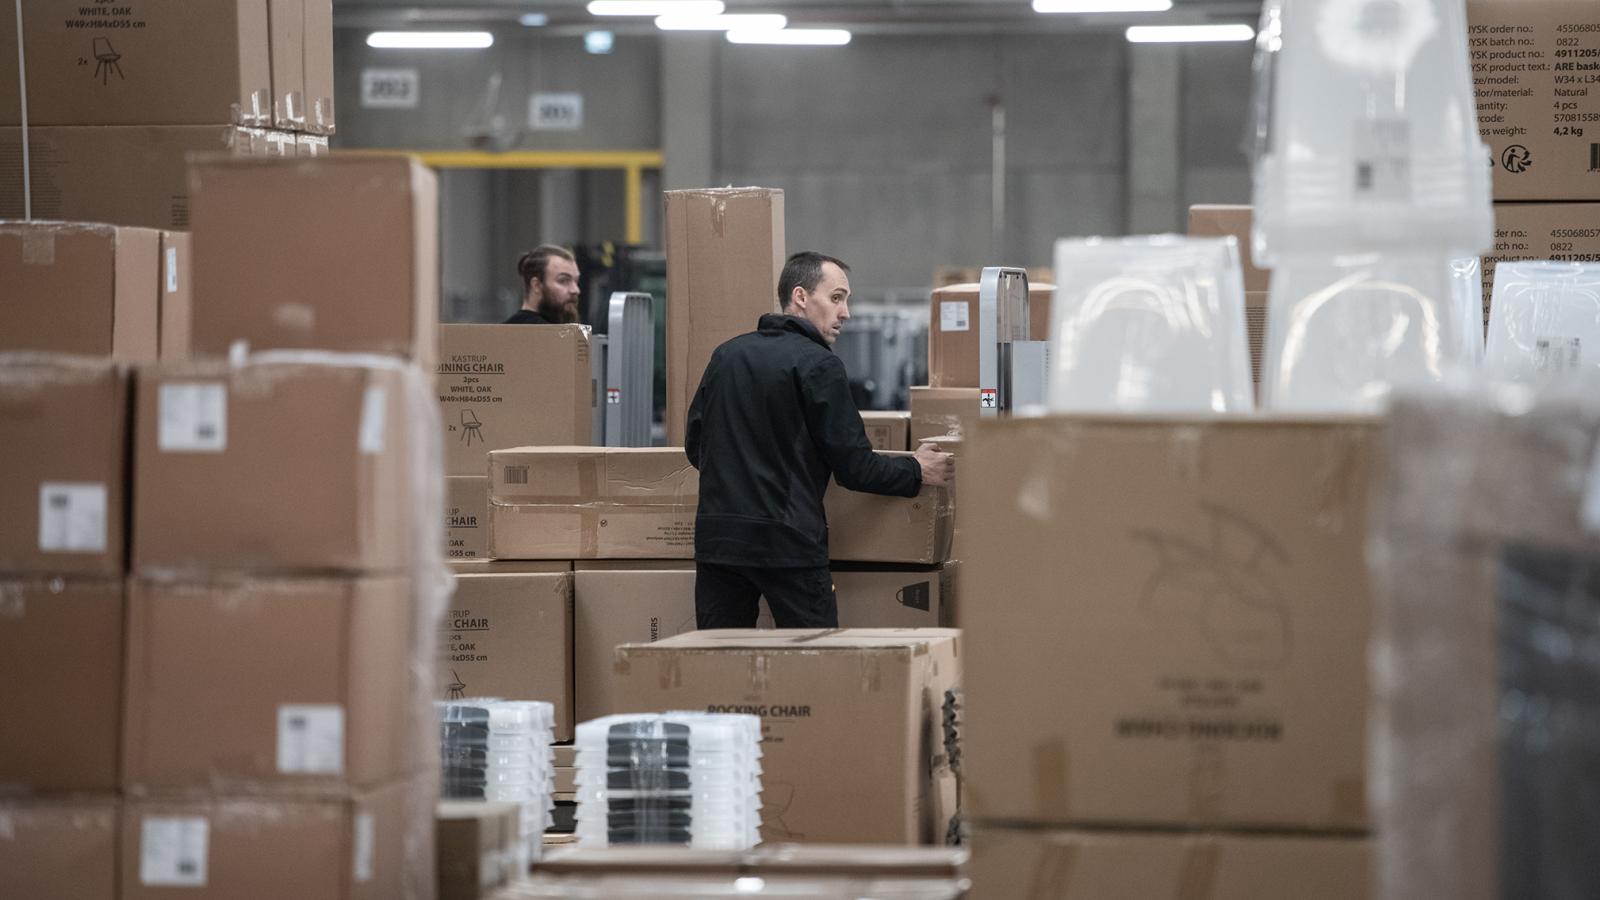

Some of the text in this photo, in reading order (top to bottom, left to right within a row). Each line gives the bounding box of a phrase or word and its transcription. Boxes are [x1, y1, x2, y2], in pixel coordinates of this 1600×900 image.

[79, 7, 131, 16] WHITE, OAK
[1490, 24, 1514, 33] order
[1517, 25, 1533, 33] no.:
[1490, 37, 1515, 46] batch
[1518, 38, 1534, 46] no.:
[1556, 37, 1579, 46] 0822
[1470, 50, 1488, 59] YSK
[1490, 49, 1526, 60] product
[1528, 51, 1544, 59] no.:
[78, 57, 88, 66] 2x
[1471, 63, 1488, 72] YSK
[1490, 62, 1526, 73] product
[1528, 63, 1550, 72] text.:
[1554, 62, 1574, 71] ARE
[1473, 75, 1519, 85] ze/model:
[1554, 75, 1575, 84] W34
[1473, 87, 1588, 97] olor/material: Natural
[1475, 101, 1578, 112] uantity: 4 pcs
[1554, 113, 1600, 122] 57081558
[1492, 126, 1527, 137] weight:
[1553, 127, 1569, 136] 4,2
[1570, 126, 1584, 137] kg
[1511, 230, 1528, 238] no.:
[1495, 242, 1573, 251] tch no.: 0822
[473, 363, 504, 372] CHAIR
[463, 376, 480, 384] 2pcs
[476, 385, 492, 393] OAK
[454, 618, 489, 628] CHAIR
[459, 643, 476, 651] OAK
[770, 705, 811, 717] CHAIR
